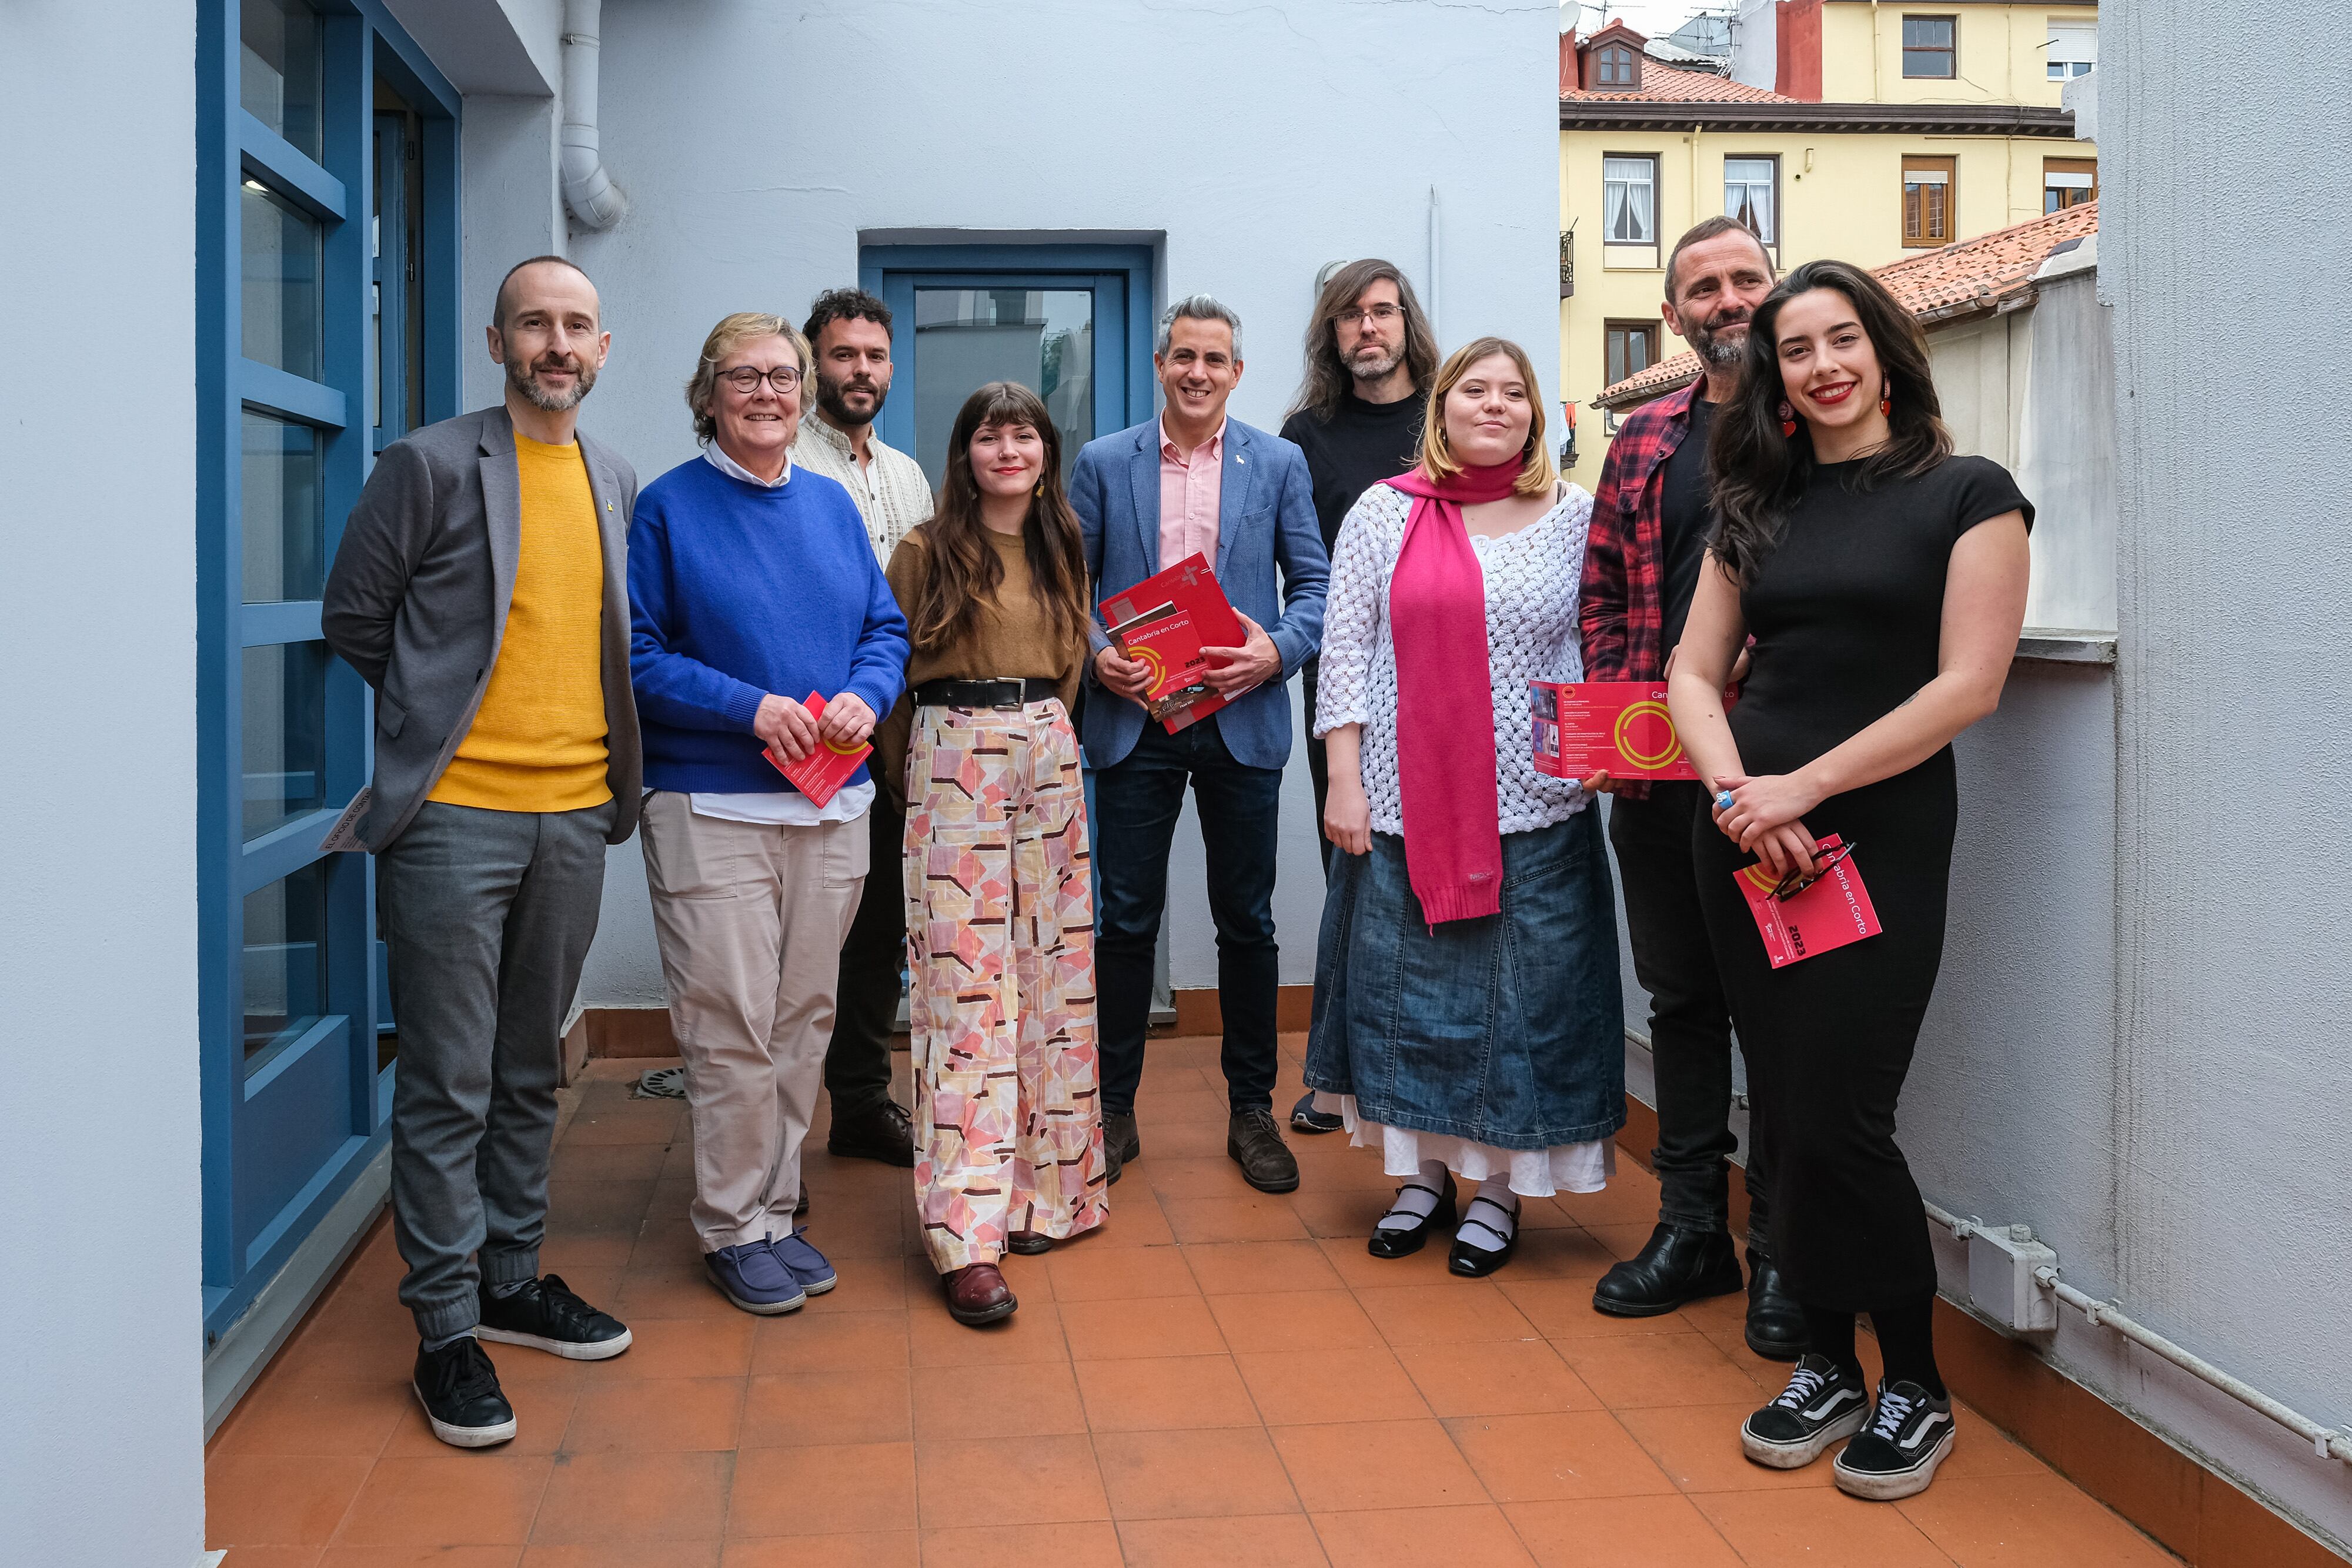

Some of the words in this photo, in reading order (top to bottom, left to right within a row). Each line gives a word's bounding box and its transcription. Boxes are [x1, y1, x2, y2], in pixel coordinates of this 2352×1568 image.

[1128, 630, 1160, 645] Cantabria
[1170, 620, 1189, 630] Corto
[1184, 657, 1205, 668] 2023
[331, 822, 349, 841] OFICIO
[346, 813, 356, 823] DE
[1846, 891, 1855, 904] en
[1852, 905, 1866, 934] Corto
[1789, 925, 1806, 957] 2023
